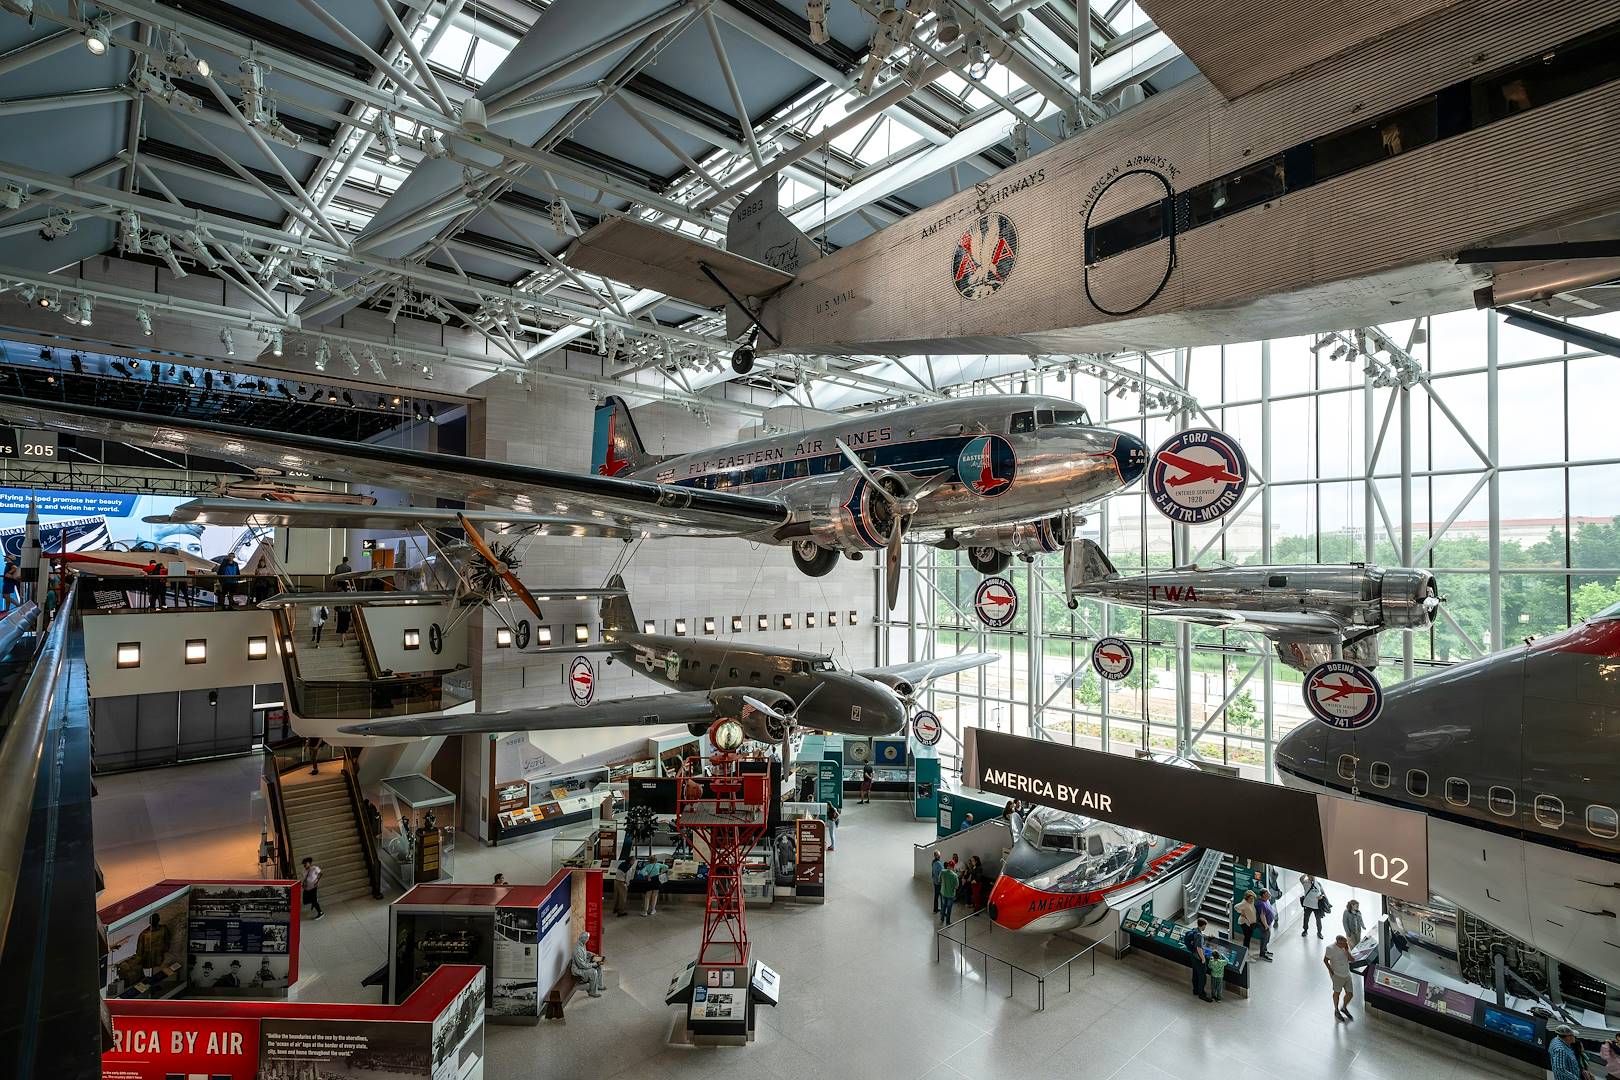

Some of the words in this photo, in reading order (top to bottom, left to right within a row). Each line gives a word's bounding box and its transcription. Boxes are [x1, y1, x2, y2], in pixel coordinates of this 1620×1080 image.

[989, 168, 1046, 206] AIRWAYS
[1078, 166, 1120, 217] AMERICAN
[764, 236, 799, 268] Ford
[795, 440, 823, 456] AIR
[834, 427, 892, 447] INES
[1182, 432, 1208, 444] FORD
[24, 444, 54, 456] 205
[0, 493, 23, 502] Flying
[53, 496, 83, 504] promote
[1156, 494, 1180, 516] 5-AT
[1178, 489, 1239, 522] TRI-MOTOR
[986, 578, 1006, 586] DOUGLAS
[1149, 585, 1198, 602] TWA
[988, 619, 1002, 627] DC-3
[1108, 671, 1124, 680] ALPHA
[1327, 663, 1355, 674] BOEING
[1334, 717, 1349, 727] 747
[984, 767, 1055, 799] AMERICA
[1057, 784, 1079, 804] BY
[1081, 790, 1112, 813] AIR
[1353, 848, 1409, 887] 102
[1028, 893, 1091, 913] AMERICAN
[112, 1029, 161, 1053] RICA
[171, 1030, 198, 1054] BY
[206, 1031, 243, 1055] AIR
